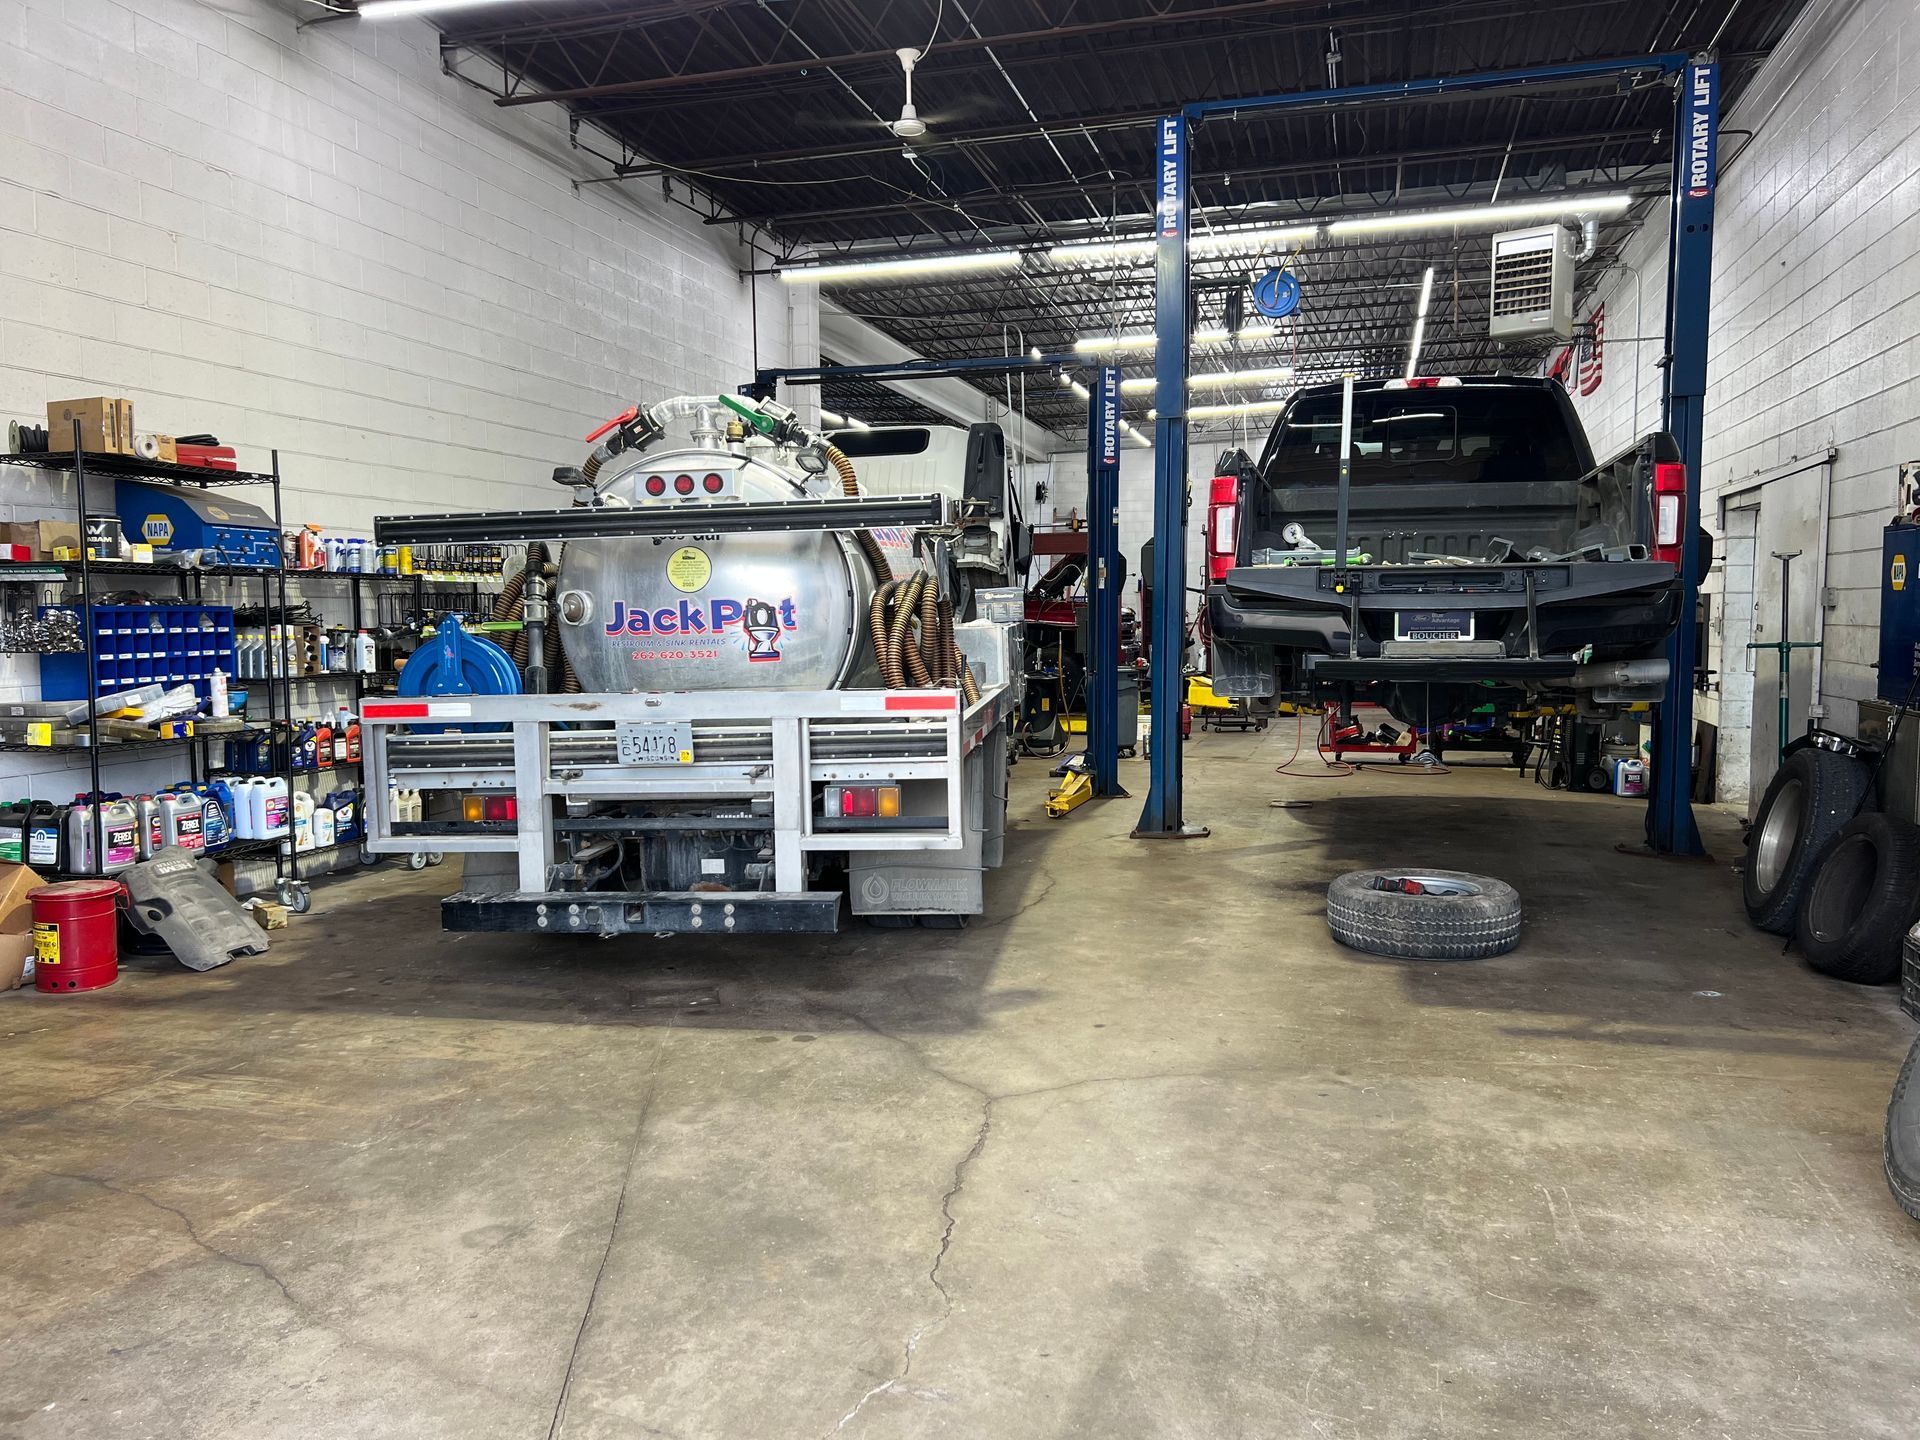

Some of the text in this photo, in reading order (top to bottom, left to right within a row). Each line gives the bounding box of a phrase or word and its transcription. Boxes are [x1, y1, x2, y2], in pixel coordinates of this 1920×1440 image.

[1691, 67, 1711, 187] ROTARY LIFT
[1163, 119, 1177, 229] ROTARY LIFT
[1105, 367, 1116, 397] LIFT
[1104, 401, 1116, 457] ROTARY
[147, 522, 169, 537] NAPA
[604, 597, 798, 637] JackPt
[665, 639, 686, 647] SINK
[689, 637, 727, 646] RENTALS
[112, 831, 132, 843] ZEREX
[181, 819, 200, 831] ZEREX
